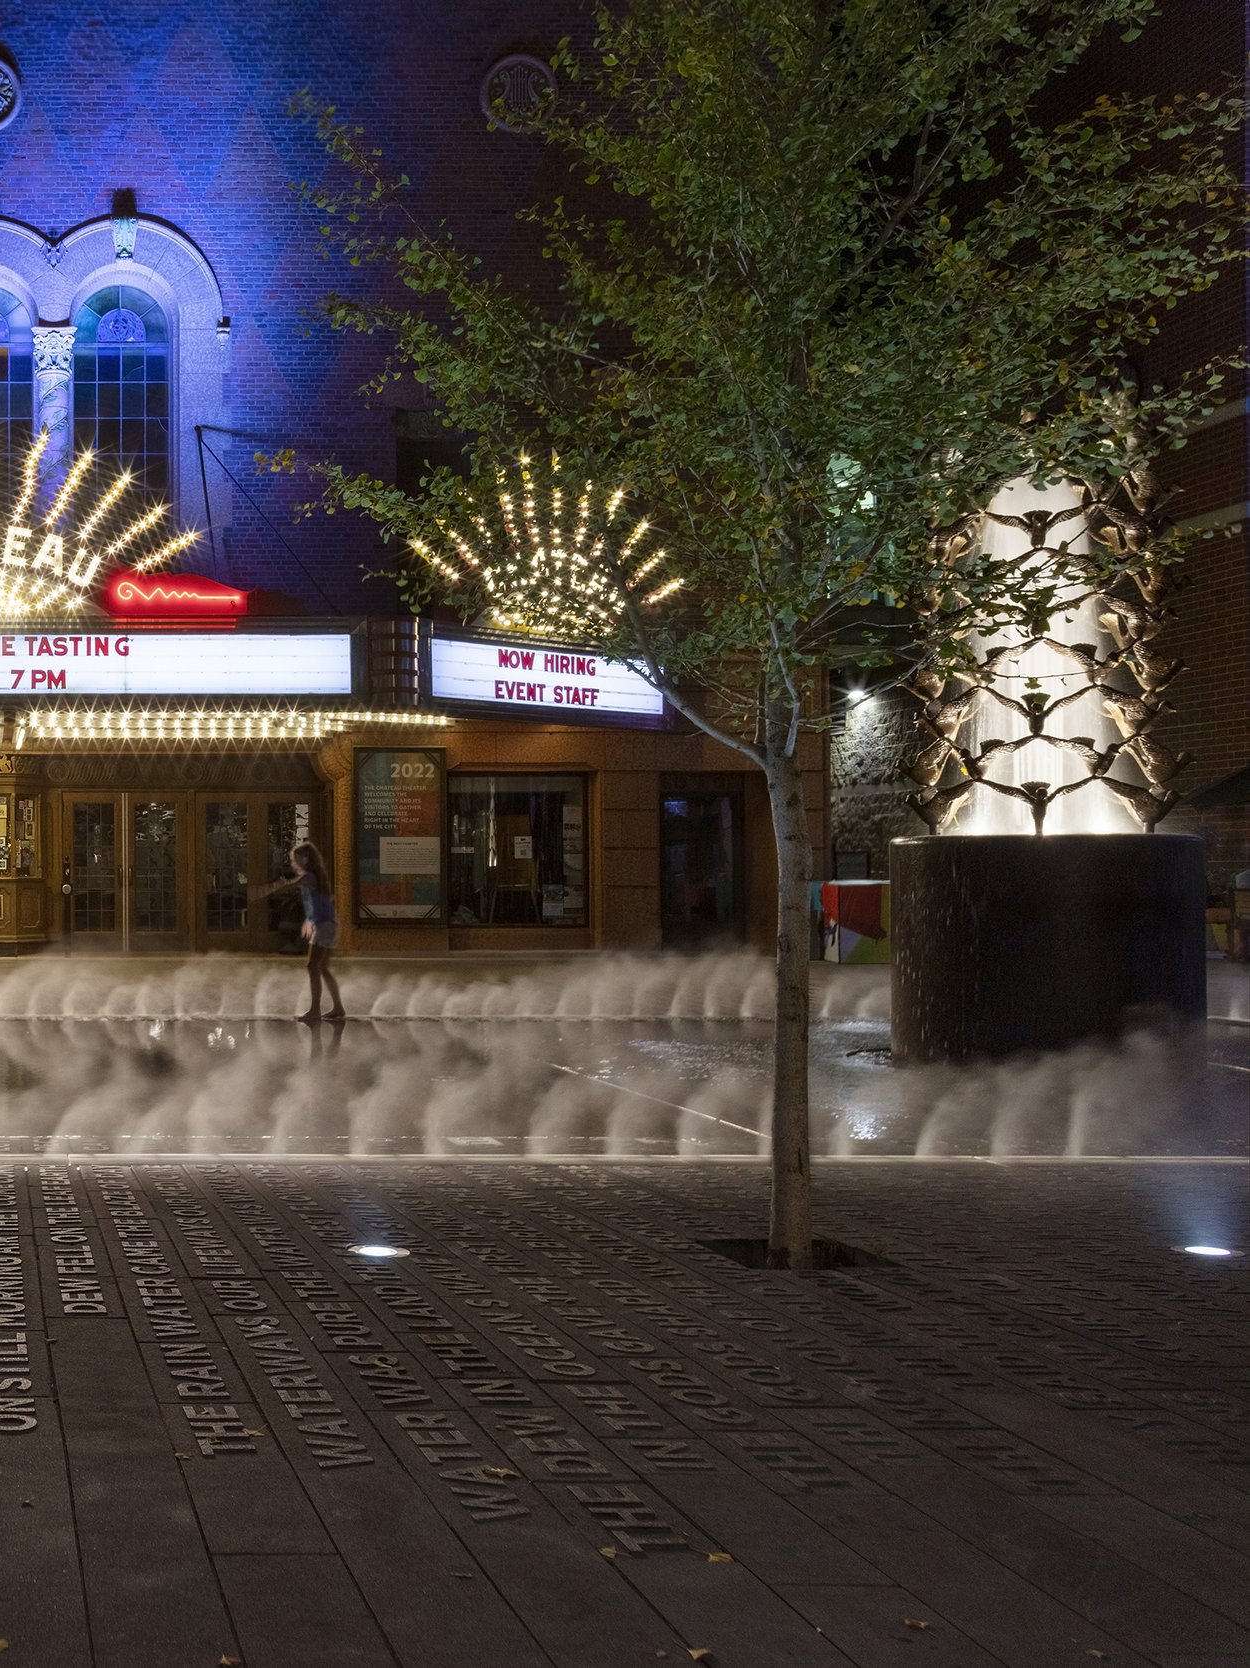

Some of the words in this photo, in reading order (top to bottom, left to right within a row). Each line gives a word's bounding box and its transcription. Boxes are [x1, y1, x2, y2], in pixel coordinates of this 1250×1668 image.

[24, 636, 130, 657] TASTING
[498, 649, 535, 670] NOW
[544, 654, 596, 676] HIRING
[10, 669, 25, 690] 7
[31, 669, 66, 690] PM
[494, 680, 546, 701] EVENT
[554, 685, 599, 706] STAFF
[390, 763, 435, 778] 2022
[40, 1186, 78, 1204] LEAF
[100, 1190, 145, 1216] BLAZE
[44, 1207, 84, 1224] THE
[110, 1218, 157, 1239] THE
[48, 1227, 89, 1242] ON
[171, 1218, 249, 1273] LIFEWAYS
[242, 1226, 317, 1266] WATER
[51, 1245, 98, 1273] FELL
[119, 1240, 174, 1273] CAME
[339, 1257, 404, 1280] THE
[278, 1271, 344, 1296] THE
[408, 1257, 497, 1294] WAVE
[503, 1276, 584, 1301] THE
[56, 1277, 108, 1313] DEW
[132, 1278, 203, 1336] WATER
[207, 1280, 272, 1310] OUR
[365, 1285, 457, 1326] LAND
[301, 1302, 387, 1345] PURE
[546, 1306, 662, 1352] GAVE
[412, 1333, 503, 1370] THE
[156, 1342, 233, 1396] RAIN
[340, 1352, 440, 1403] WAS
[227, 1316, 387, 1467] WATERWAYS
[457, 1379, 535, 1401] IN
[618, 1359, 771, 1423] GODS
[558, 1384, 676, 1431] THE
[179, 1404, 260, 1454] THE
[487, 1409, 618, 1474] DEW
[385, 1411, 542, 1518] WATER
[622, 1440, 725, 1470] IN
[561, 1484, 700, 1550] THE
